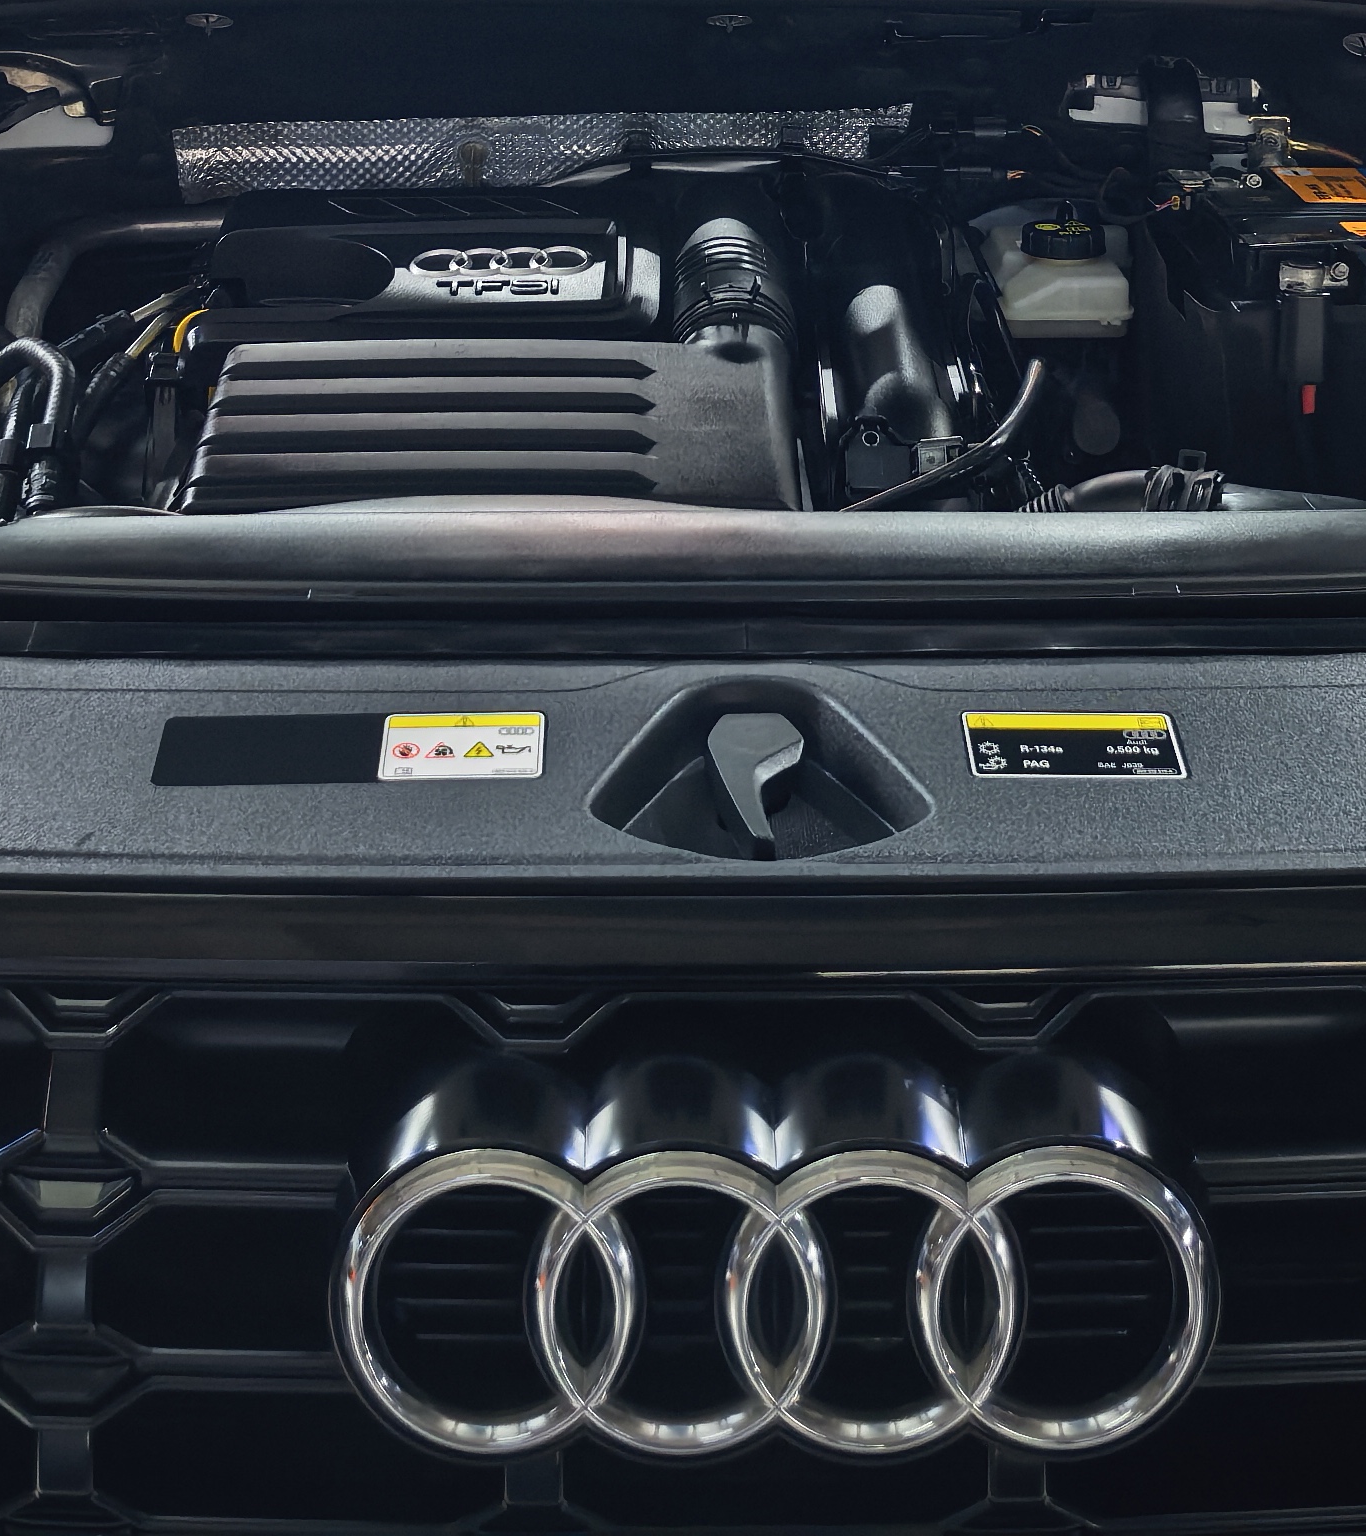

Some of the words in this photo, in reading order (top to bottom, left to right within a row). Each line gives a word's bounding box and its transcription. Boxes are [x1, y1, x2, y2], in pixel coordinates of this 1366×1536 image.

[436, 278, 560, 296] TFSI
[1019, 743, 1064, 754] R-134a
[1143, 745, 1160, 756] kg
[1023, 759, 1051, 769] PAG
